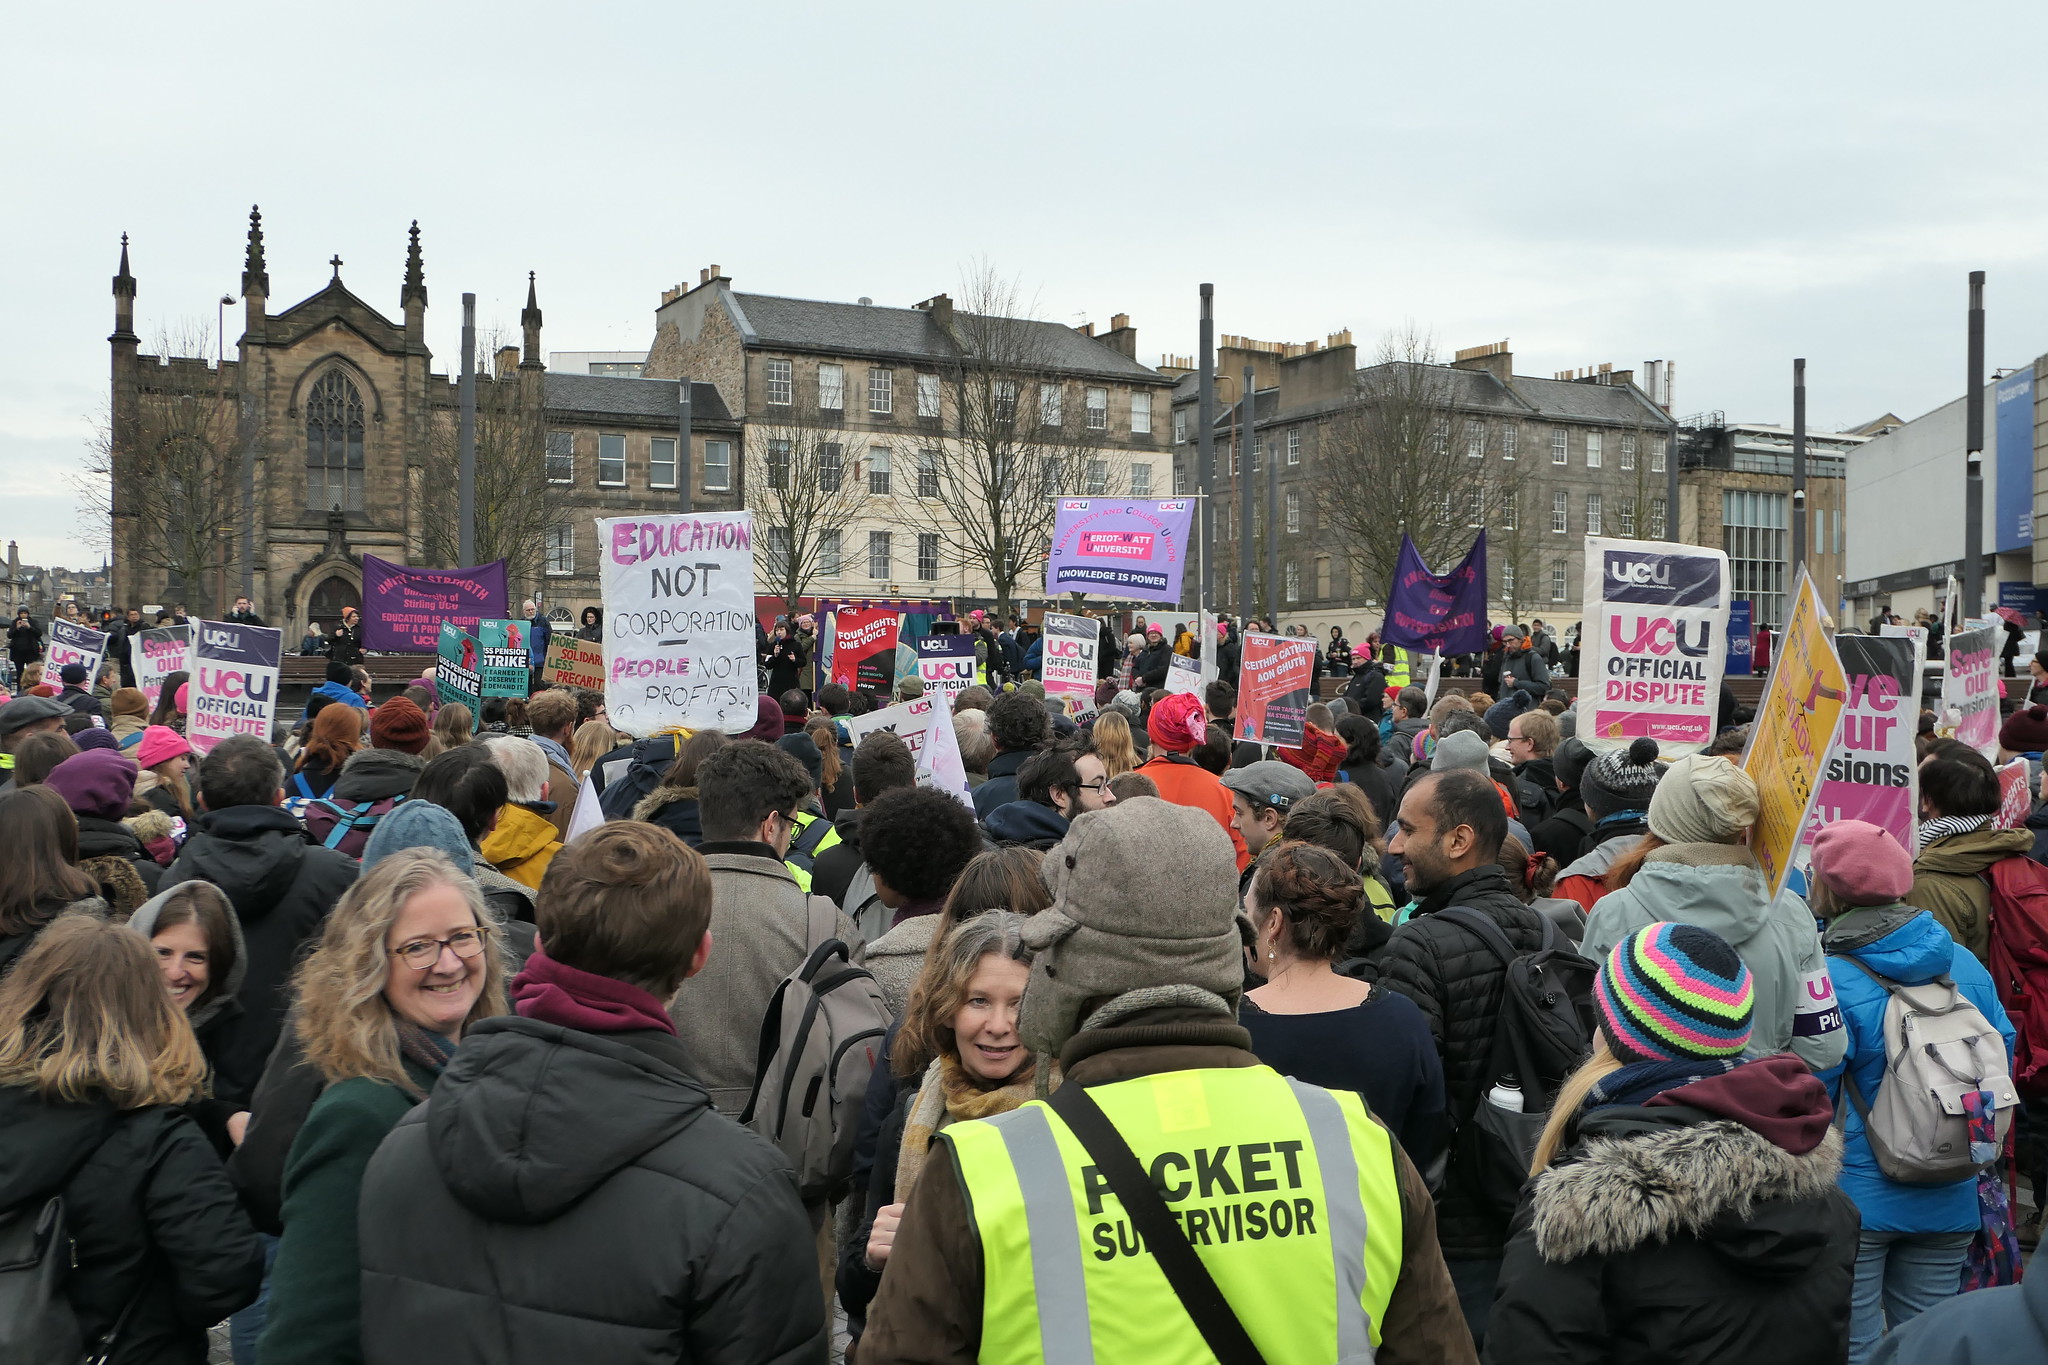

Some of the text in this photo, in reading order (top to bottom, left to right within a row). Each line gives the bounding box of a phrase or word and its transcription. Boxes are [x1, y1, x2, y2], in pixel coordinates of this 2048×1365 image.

[1065, 502, 1088, 510] UCU
[1160, 502, 1184, 510] UCU
[611, 519, 752, 565] EDUCATION
[651, 562, 721, 599] NOT
[1058, 569, 1166, 586] KNOWLEDGE IS POWER
[1611, 561, 1669, 585] UCU
[378, 573, 408, 595] UNITY
[404, 599, 436, 611] Stirling
[450, 592, 459, 602] of
[381, 612, 430, 624] EDUCATION
[432, 615, 440, 624] IS
[452, 616, 480, 626] RIGHT
[393, 623, 410, 633] NOT
[412, 624, 419, 633] A
[443, 623, 457, 636] UCU
[613, 609, 754, 639] CORPORATION
[837, 617, 897, 641] FOUR FIGHTS
[1049, 616, 1075, 629] UCU
[56, 625, 81, 640] UCU
[203, 628, 240, 649] UCU
[550, 634, 579, 650] MORE
[838, 627, 887, 650] ONE VOICE
[1251, 637, 1270, 647] UCU
[1609, 614, 1711, 658] UCU
[1906, 629, 1920, 638] UCU
[143, 639, 185, 659] Save
[494, 648, 527, 656] PENSION
[921, 639, 949, 650] UCU
[1048, 639, 1094, 661] UCU
[51, 645, 96, 672] UCU
[157, 656, 185, 672] our
[548, 656, 574, 671] LESS
[560, 648, 603, 667] SOLIDARI
[1046, 657, 1093, 671] OFFICIAL
[1173, 655, 1194, 668] UCU
[1244, 643, 1314, 671] CEITHIR CATHAN
[1951, 647, 1992, 679] Save
[438, 654, 481, 682] USS PENSION
[611, 655, 750, 684] PEOPLE NOT
[923, 662, 973, 680] UCU
[1046, 666, 1093, 681] DISPUTE
[1257, 669, 1276, 683] AON
[1276, 656, 1306, 676] GHUTH
[1607, 656, 1707, 681] OFFICIAL
[200, 666, 270, 702] UCU
[437, 664, 479, 697] STRIKE
[555, 670, 605, 690] PRECARIT
[1174, 671, 1201, 688] SAV
[1965, 670, 1992, 697] our
[1605, 679, 1706, 706] DISPUTE
[1848, 673, 1900, 712] ve
[196, 696, 267, 719] OFFICIAL
[194, 712, 266, 737] DISPUTE
[1651, 722, 1703, 733] www.ucu.org.uk
[1836, 714, 1897, 752] ur
[1826, 752, 1910, 788] sions
[1081, 1140, 1304, 1216] PCKET
[1092, 1197, 1318, 1262] SURVISOR
